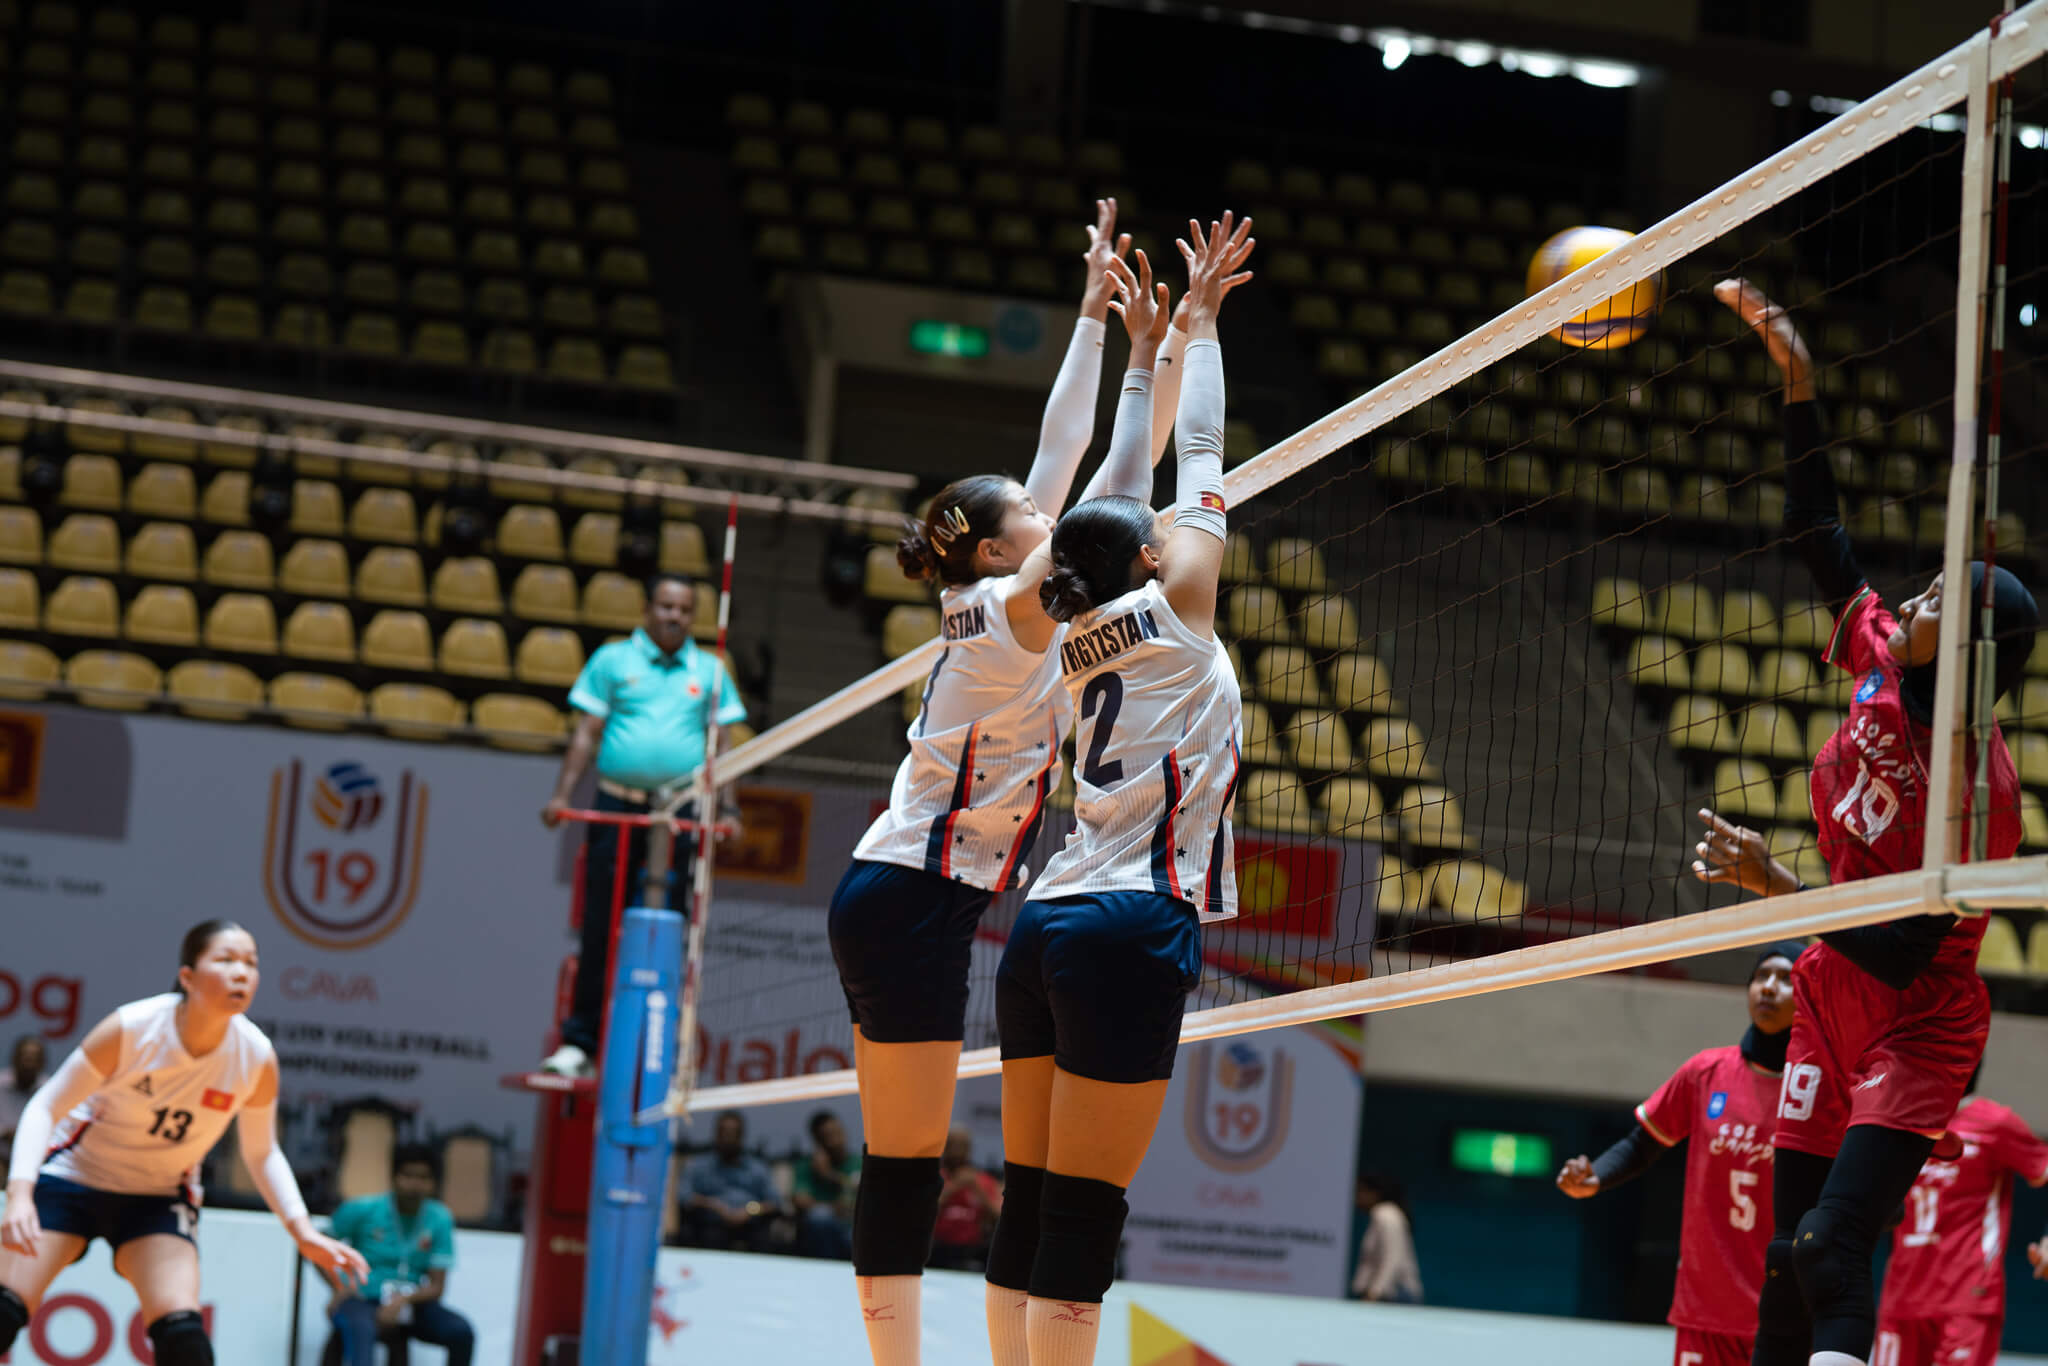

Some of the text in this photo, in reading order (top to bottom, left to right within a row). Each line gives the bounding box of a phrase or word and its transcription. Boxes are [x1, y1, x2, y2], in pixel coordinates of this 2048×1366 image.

[1081, 671, 1124, 788] 2
[305, 850, 377, 906] 19
[280, 967, 379, 1004] CAVA
[1776, 1061, 1823, 1122] 19
[147, 1106, 194, 1144] 13
[1214, 1103, 1262, 1140] 19
[1729, 1169, 1759, 1233] 5
